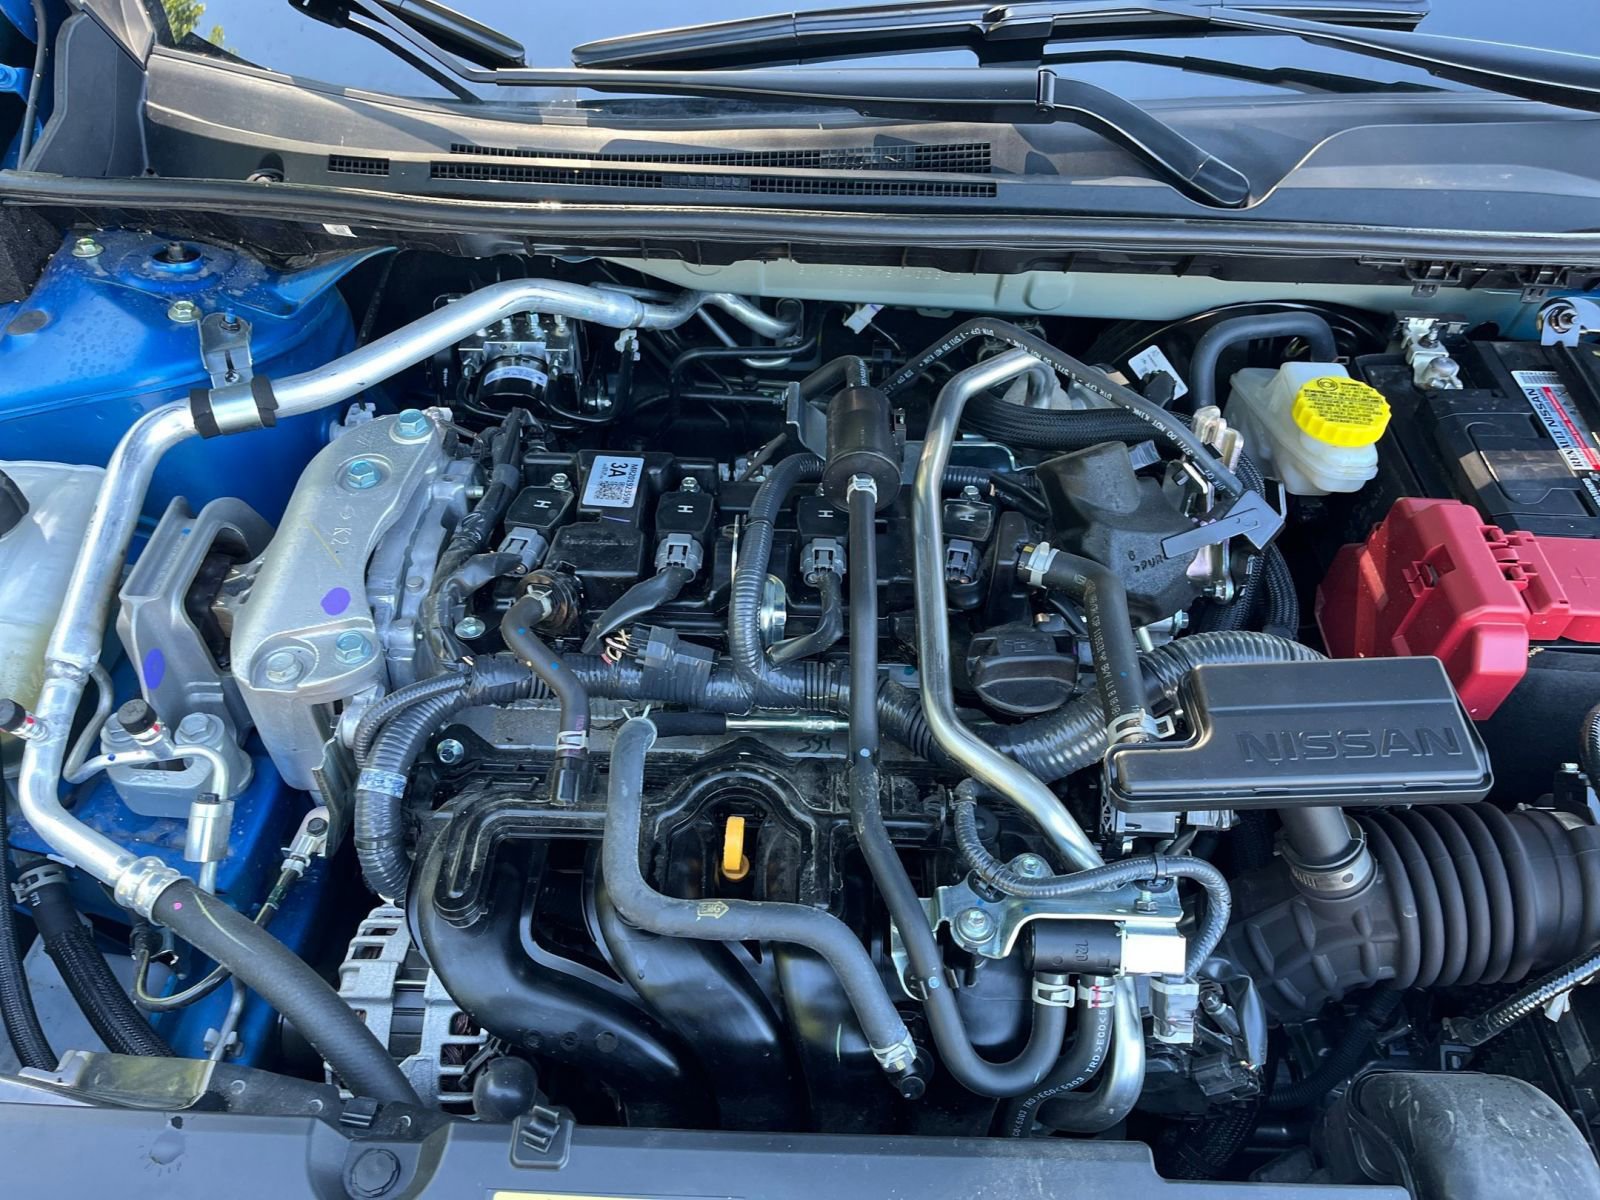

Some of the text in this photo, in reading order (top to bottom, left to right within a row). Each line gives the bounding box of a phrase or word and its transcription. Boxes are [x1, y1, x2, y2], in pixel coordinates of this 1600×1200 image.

[1131, 406, 1151, 422] KINK
[1525, 388, 1557, 428] NISSAN
[1151, 418, 1167, 432] NOT
[1166, 429, 1178, 441] DO
[607, 462, 629, 478] 3A
[677, 504, 694, 514] H
[817, 509, 834, 518] H
[1235, 726, 1463, 764] NISSAN
